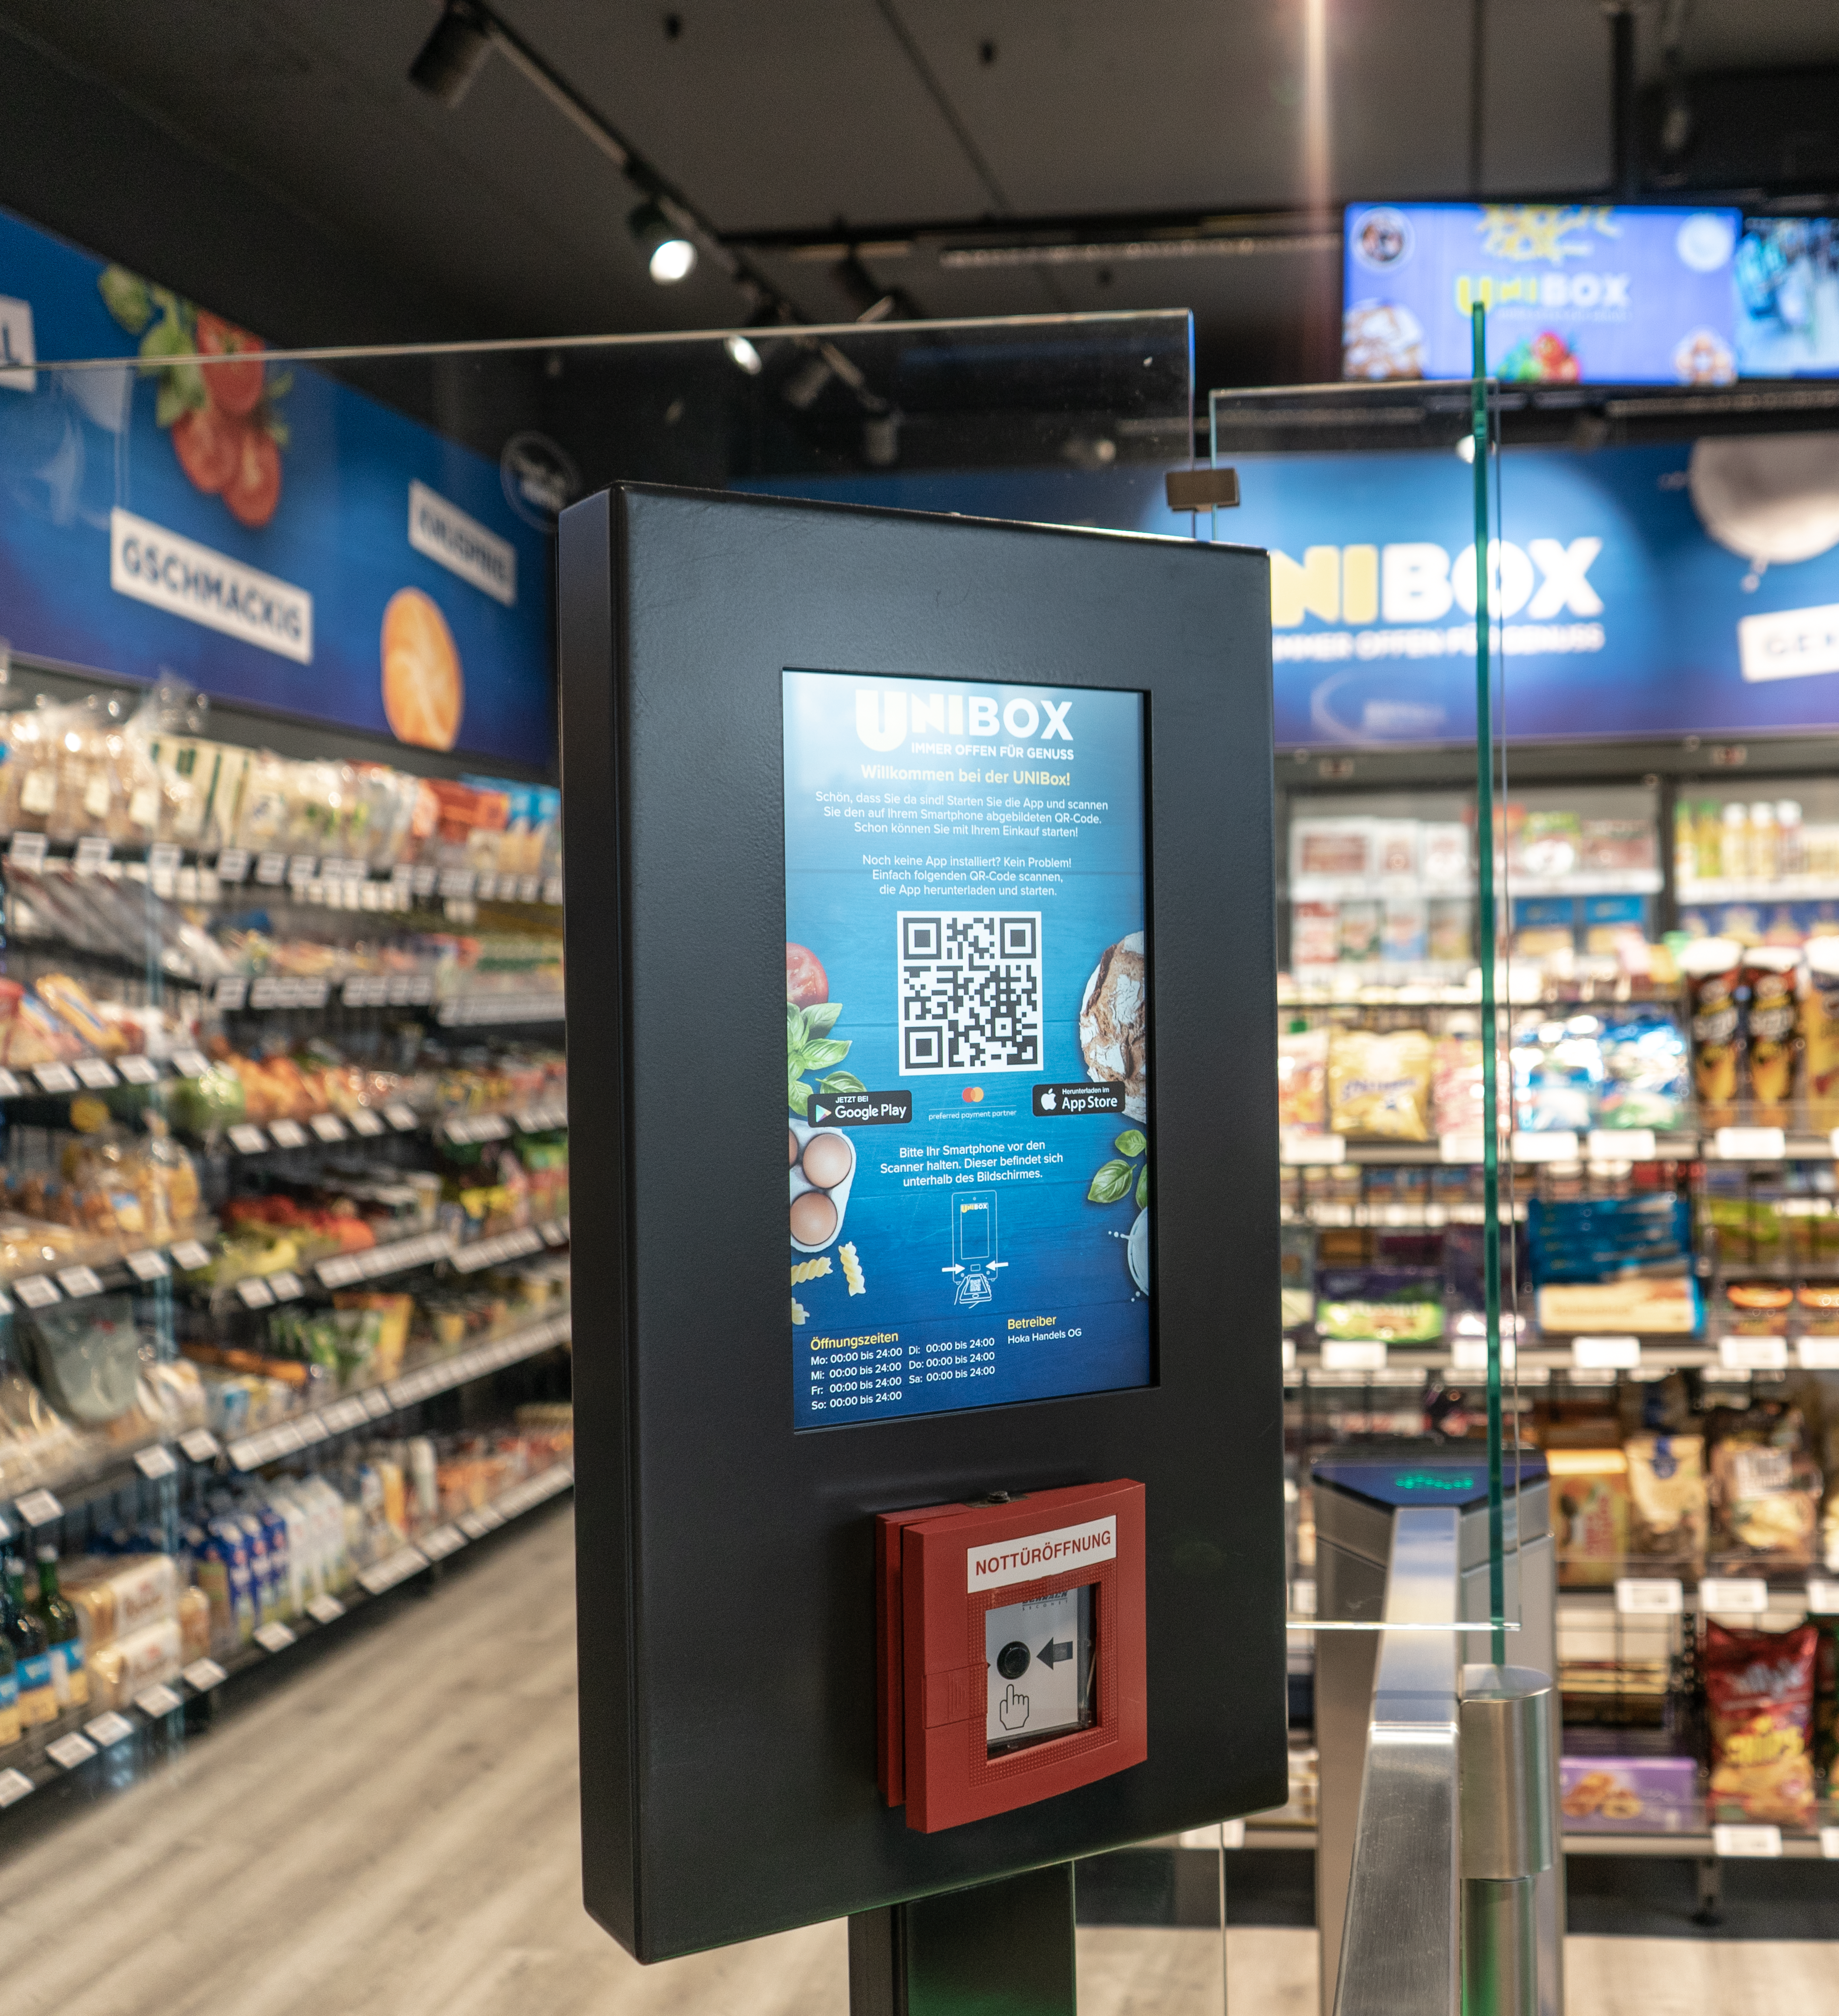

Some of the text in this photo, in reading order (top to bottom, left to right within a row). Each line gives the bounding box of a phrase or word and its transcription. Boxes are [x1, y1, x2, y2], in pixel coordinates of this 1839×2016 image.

[1455, 272, 1631, 316] UNIBOX
[122, 536, 301, 643] GSCHMACKIG
[1271, 536, 1603, 627] NIBOX
[855, 689, 1074, 752] UNIBOX
[911, 742, 1074, 760] IMMER OFFEN FÜR GENUSS
[861, 765, 1070, 786] Willkommen bei der UNIBox!
[815, 790, 1108, 810] Schön, dass Sie da sind! Starten Sie die App und scannen
[824, 806, 1101, 824] Sie den auf Ihrem Smartphone abgebildeten QR-Code.
[854, 822, 1078, 837] Schon können Sie mit Ihrem Einkauf starten!
[863, 854, 1071, 868] Noch keine App installiert? Kein Problem!
[872, 869, 1063, 883] Einfach folgenden QR-Code scannen,
[879, 884, 1057, 897] die App herunterladen und starten.
[835, 1103, 906, 1120] Google Play
[1062, 1096, 1118, 1112] App Store
[928, 1110, 1017, 1121] preferred payment partner
[899, 1140, 1045, 1158] Bitte Ihr Smartphone vor den
[880, 1152, 1063, 1174] Scanner halten. Dieser befindet sich
[903, 1169, 1043, 1187] unterhalb des Bildschirmes.
[961, 1203, 988, 1213] UNIBOX
[1007, 1315, 1057, 1330] Betreiber
[810, 1332, 898, 1350] Öffnungszeiten
[1008, 1328, 1082, 1344] Hoka Handels OG
[908, 1337, 995, 1355] Di: 00:00 bis 24:00
[811, 1347, 902, 1365] Mo: 00:00 bis 24:00
[908, 1351, 995, 1369] Do: 00:00 bis 24:00
[811, 1362, 901, 1380] Mi: 00:00 bis 24:00
[908, 1365, 995, 1383] Sa: 00:00 bis 24:00
[811, 1376, 902, 1395] Fr: 00:00 bis 24:00
[811, 1391, 902, 1410] So: 00:00 bis 24:00
[975, 1531, 1111, 1576] NOTTÜRÖFFNUNG
